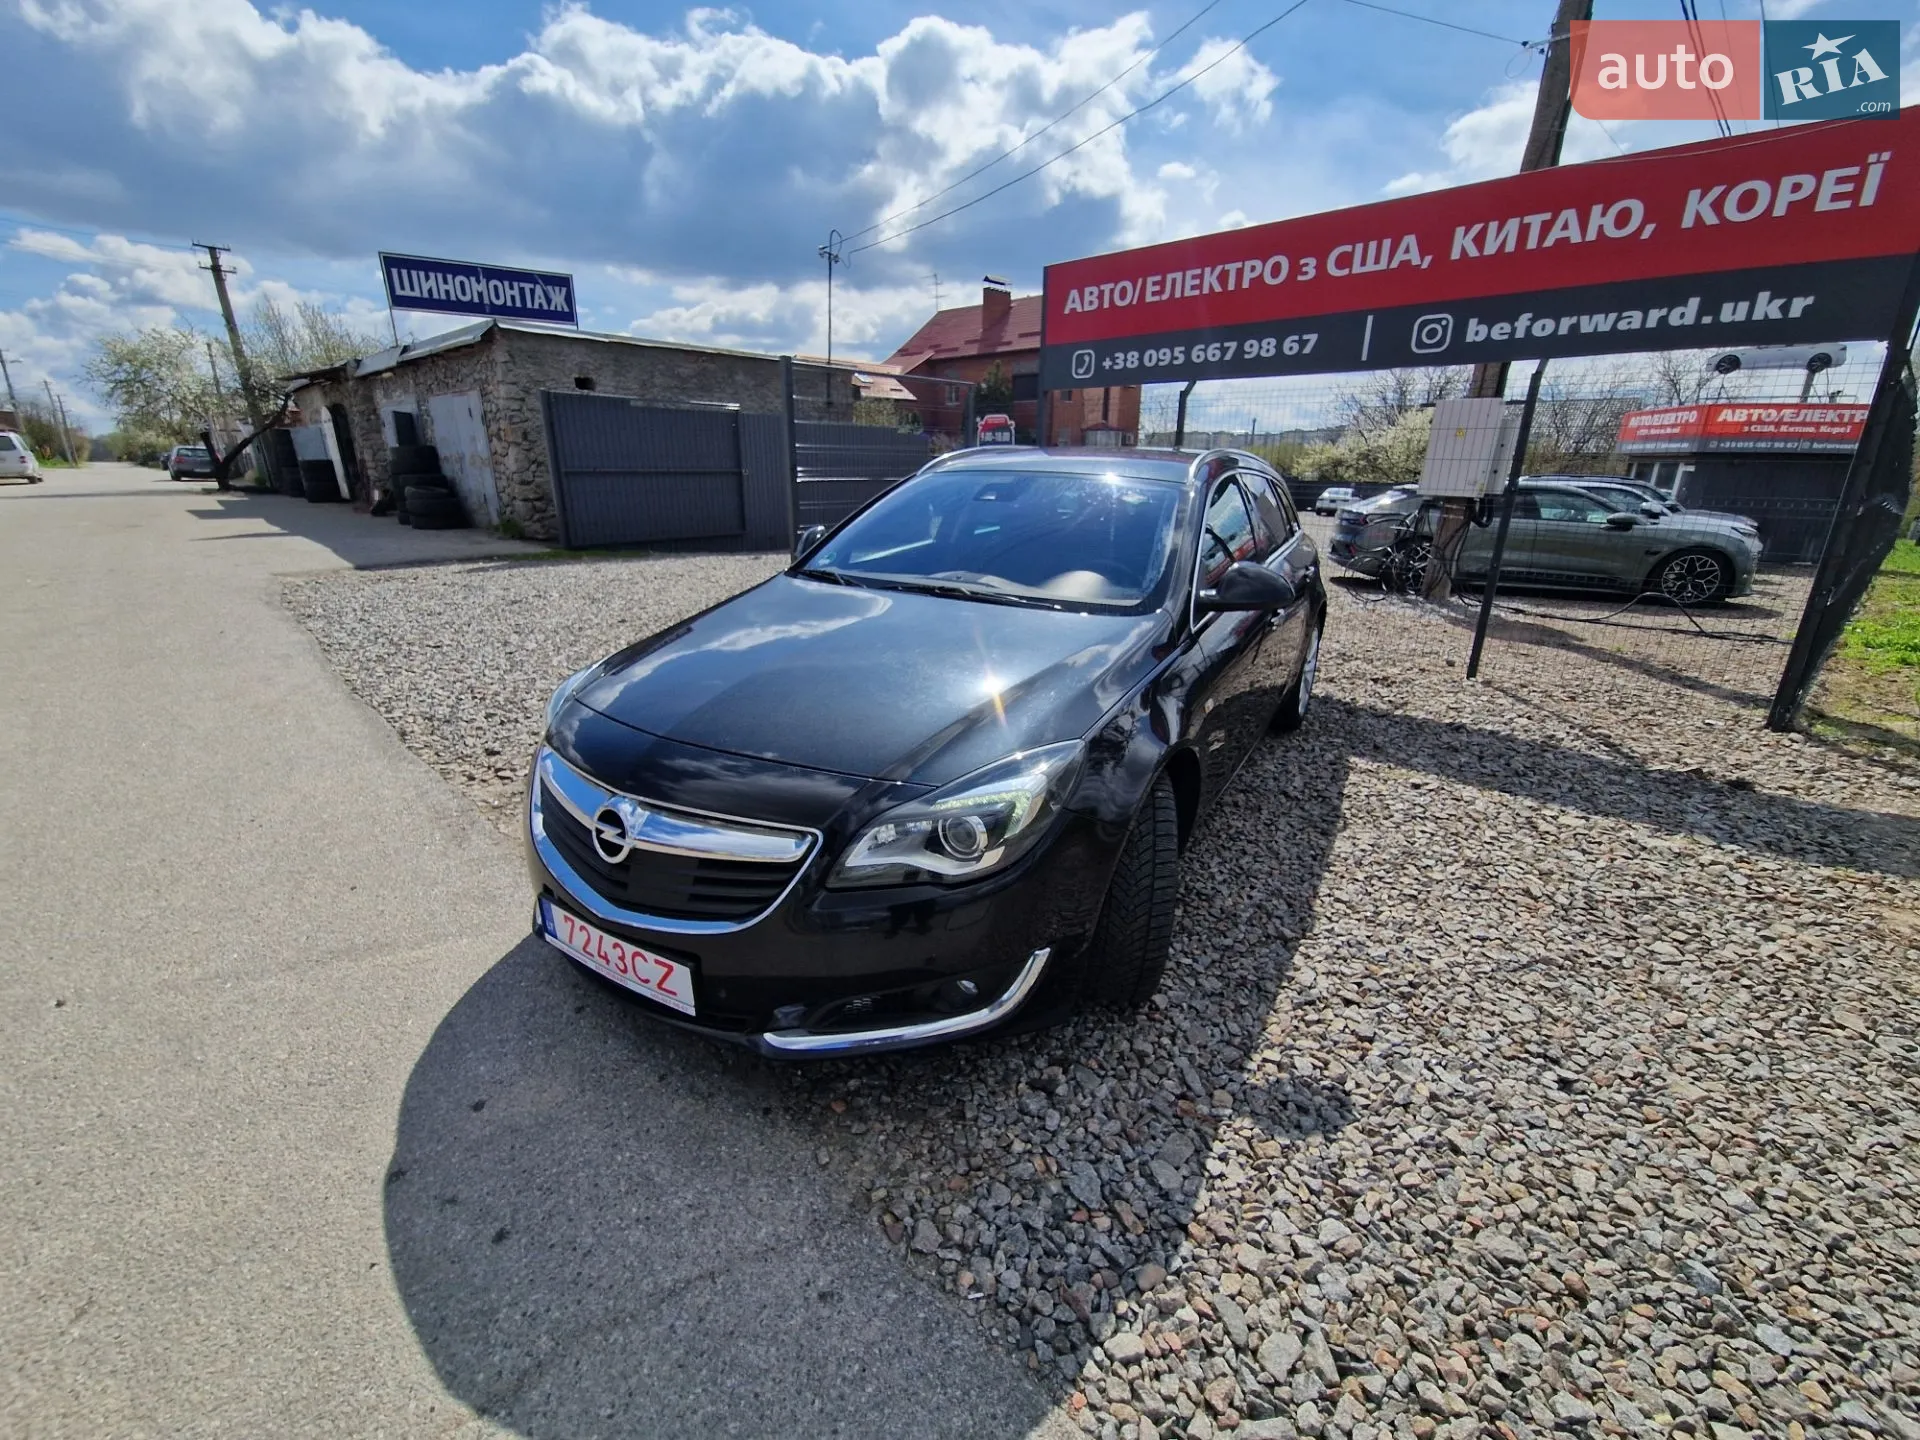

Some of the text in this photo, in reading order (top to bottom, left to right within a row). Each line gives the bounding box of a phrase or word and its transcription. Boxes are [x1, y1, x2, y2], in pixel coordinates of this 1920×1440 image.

[1064, 151, 1893, 315] АВТО/ЕЛЕКТРО з США, КИТАЮ, КОРЕЇ
[390, 267, 570, 313] ШИНОМОНТАЖ
[1465, 291, 1815, 343] beforward.ukr
[1102, 333, 1318, 370] +38 095 667 98 67
[563, 914, 678, 997] 7243CZ
